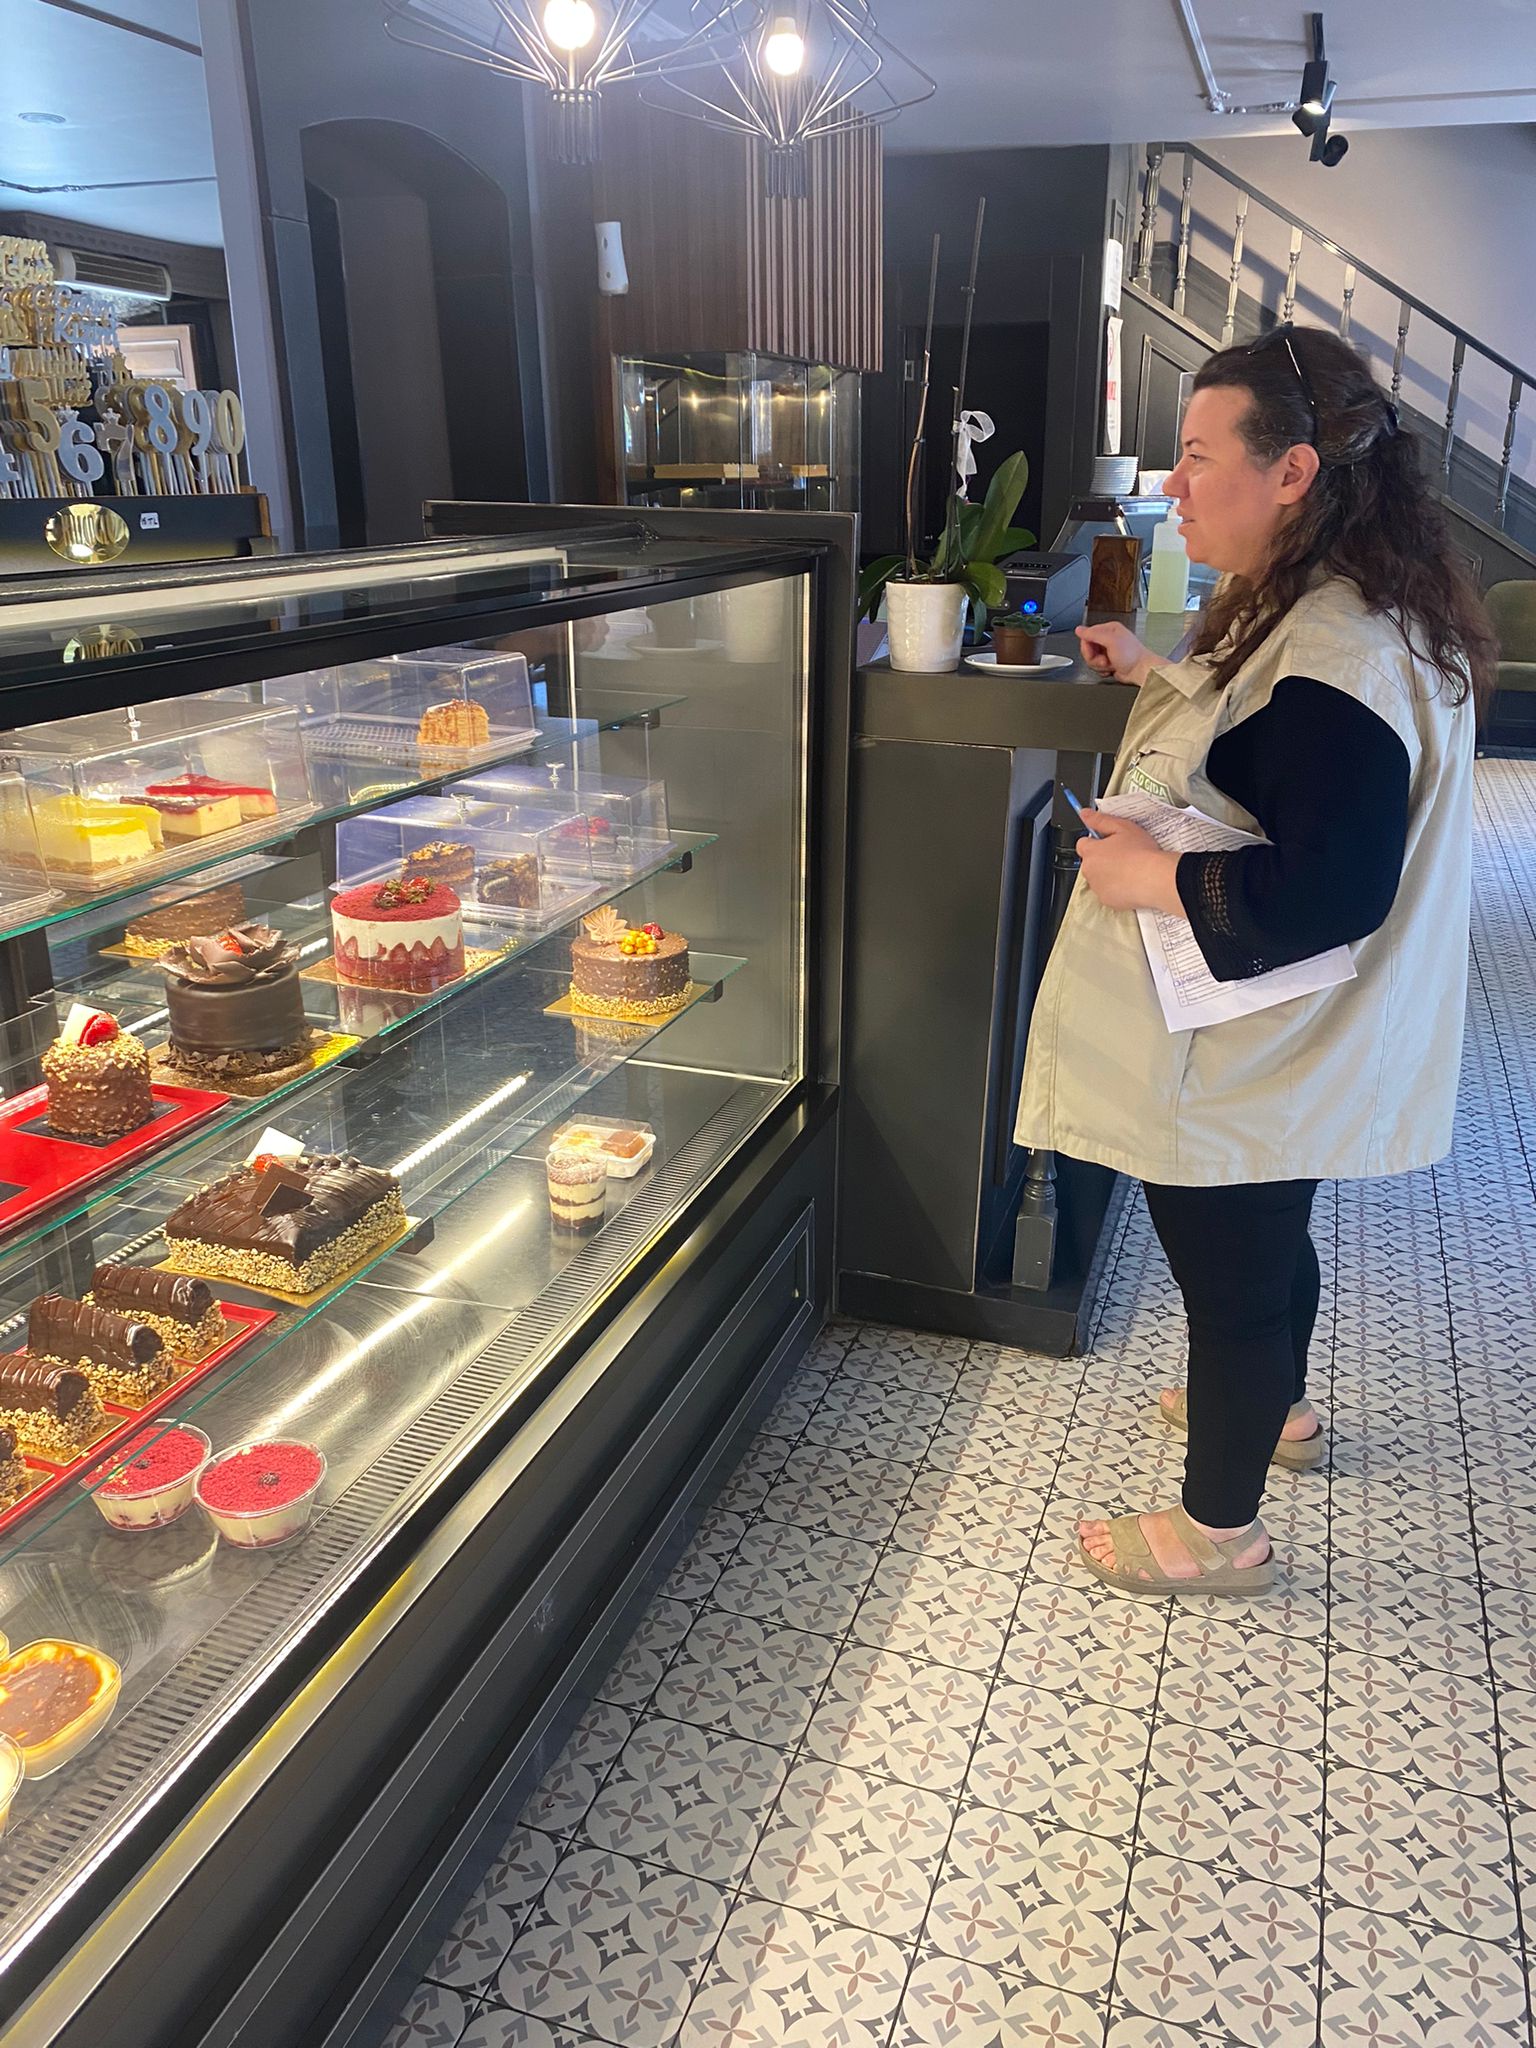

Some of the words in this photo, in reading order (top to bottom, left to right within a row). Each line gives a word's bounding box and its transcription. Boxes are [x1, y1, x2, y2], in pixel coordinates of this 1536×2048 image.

[20, 378, 61, 453] 5
[59, 420, 105, 482] 6
[94, 420, 135, 481] 7
[144, 384, 178, 454] 8
[182, 389, 212, 456] 9
